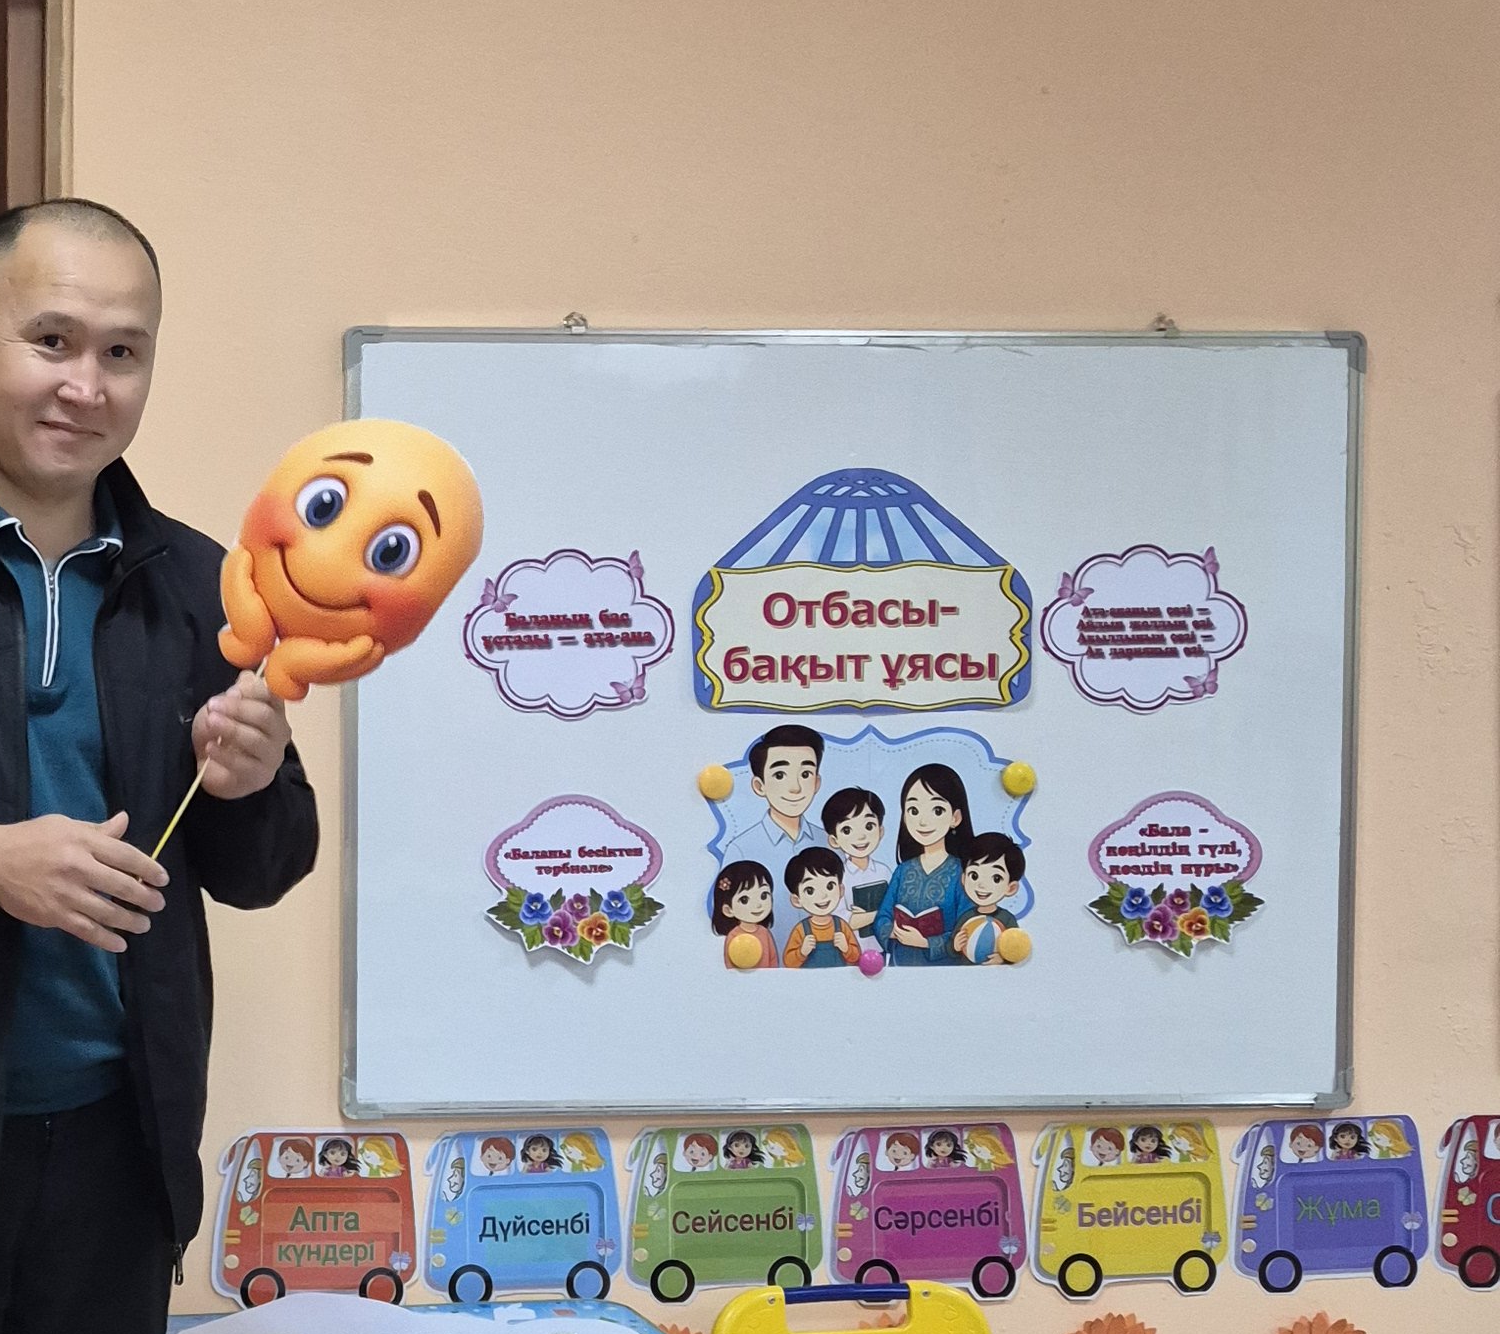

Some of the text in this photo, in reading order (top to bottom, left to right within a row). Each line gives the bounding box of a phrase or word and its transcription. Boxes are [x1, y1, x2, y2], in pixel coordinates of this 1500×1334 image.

[762, 590, 959, 628] Отбасы-
[583, 631, 654, 647] ата-ана
[723, 646, 1000, 689] бақыт ұясы
[289, 1205, 360, 1232] Апта
[671, 1206, 794, 1235] Сейсенбі
[874, 1201, 1000, 1236] Сәрсенбі
[1077, 1198, 1202, 1229] Бейсенбі
[1297, 1195, 1382, 1227] Жұма
[479, 1212, 590, 1243] Дүйсенбі
[277, 1240, 375, 1267] күндері
